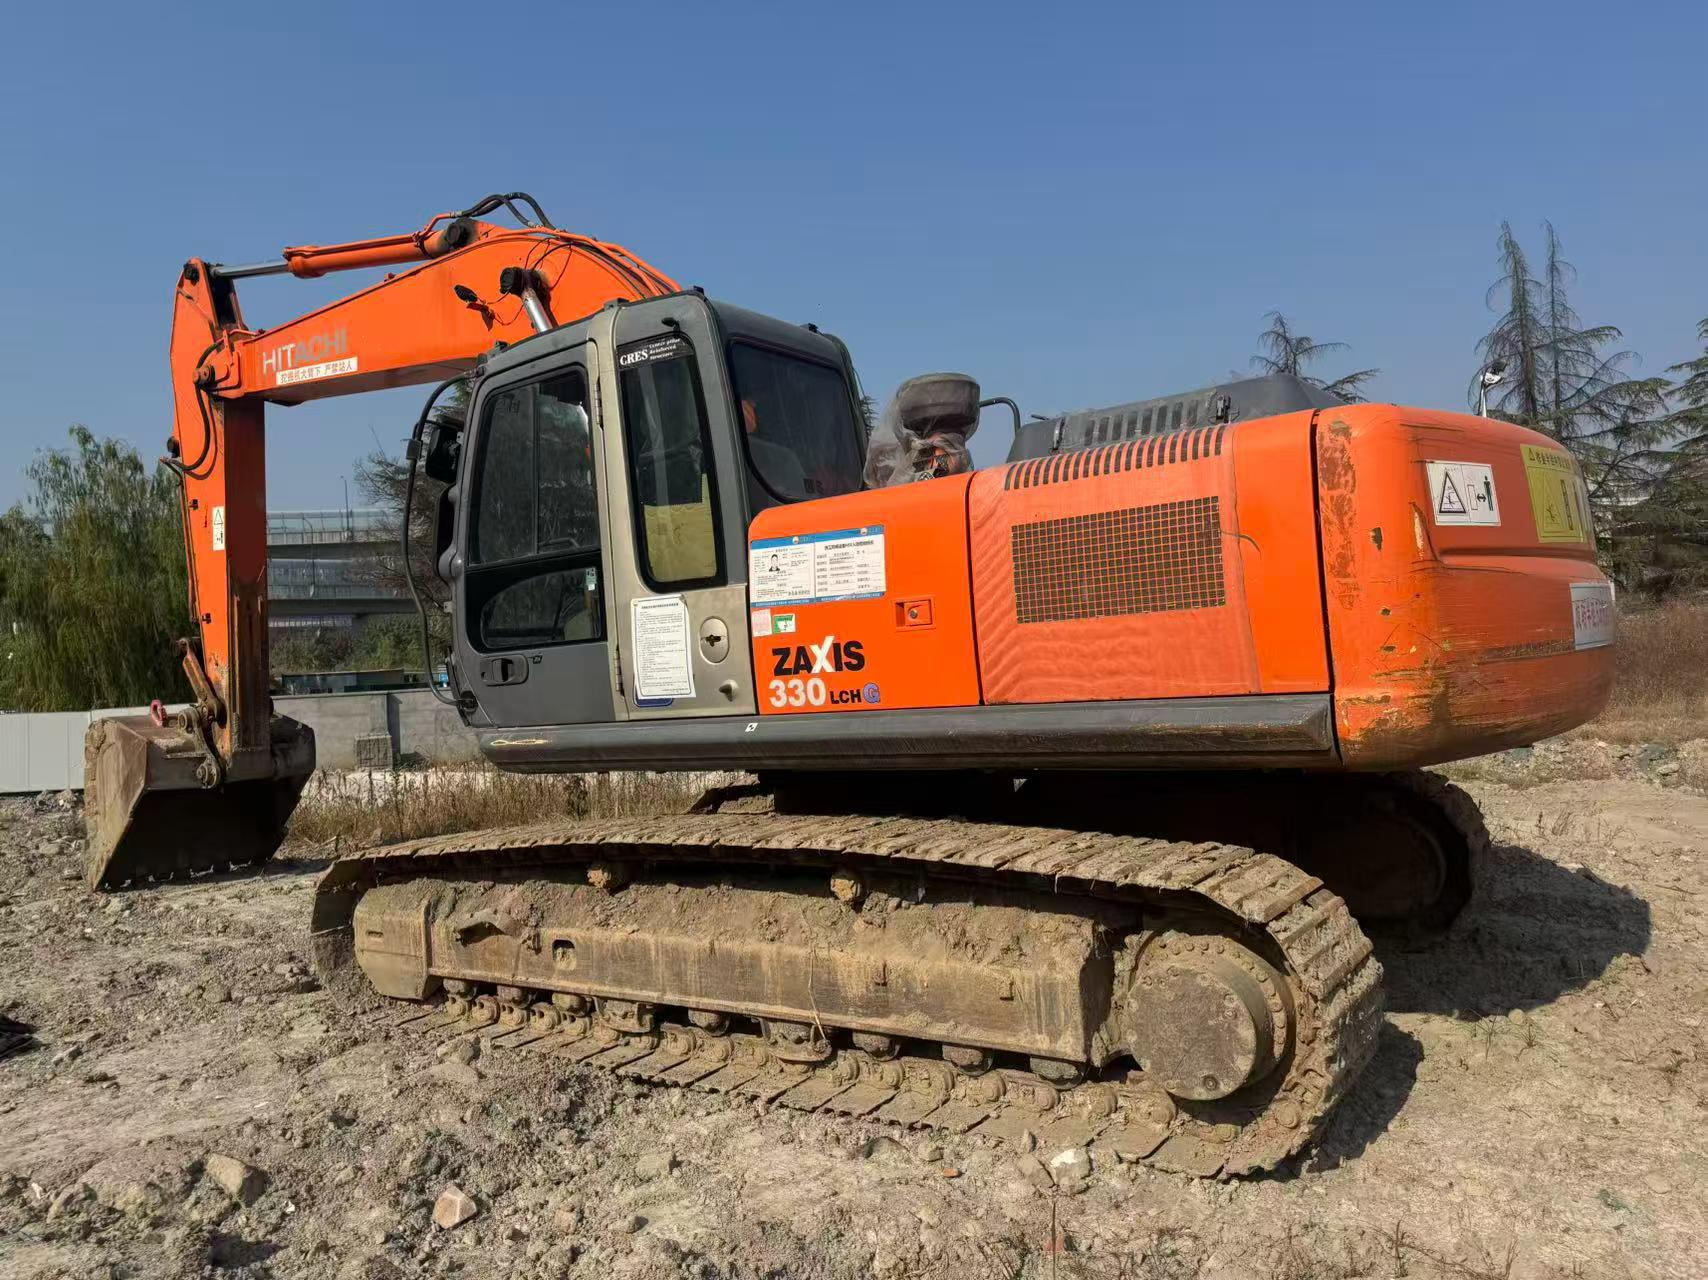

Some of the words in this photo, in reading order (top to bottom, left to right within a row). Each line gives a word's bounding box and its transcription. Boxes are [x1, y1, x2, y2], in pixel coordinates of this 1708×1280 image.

[262, 327, 347, 376] HITACHI
[619, 348, 649, 366] CRES
[772, 635, 866, 677] ZAXIS
[769, 677, 827, 708] 330
